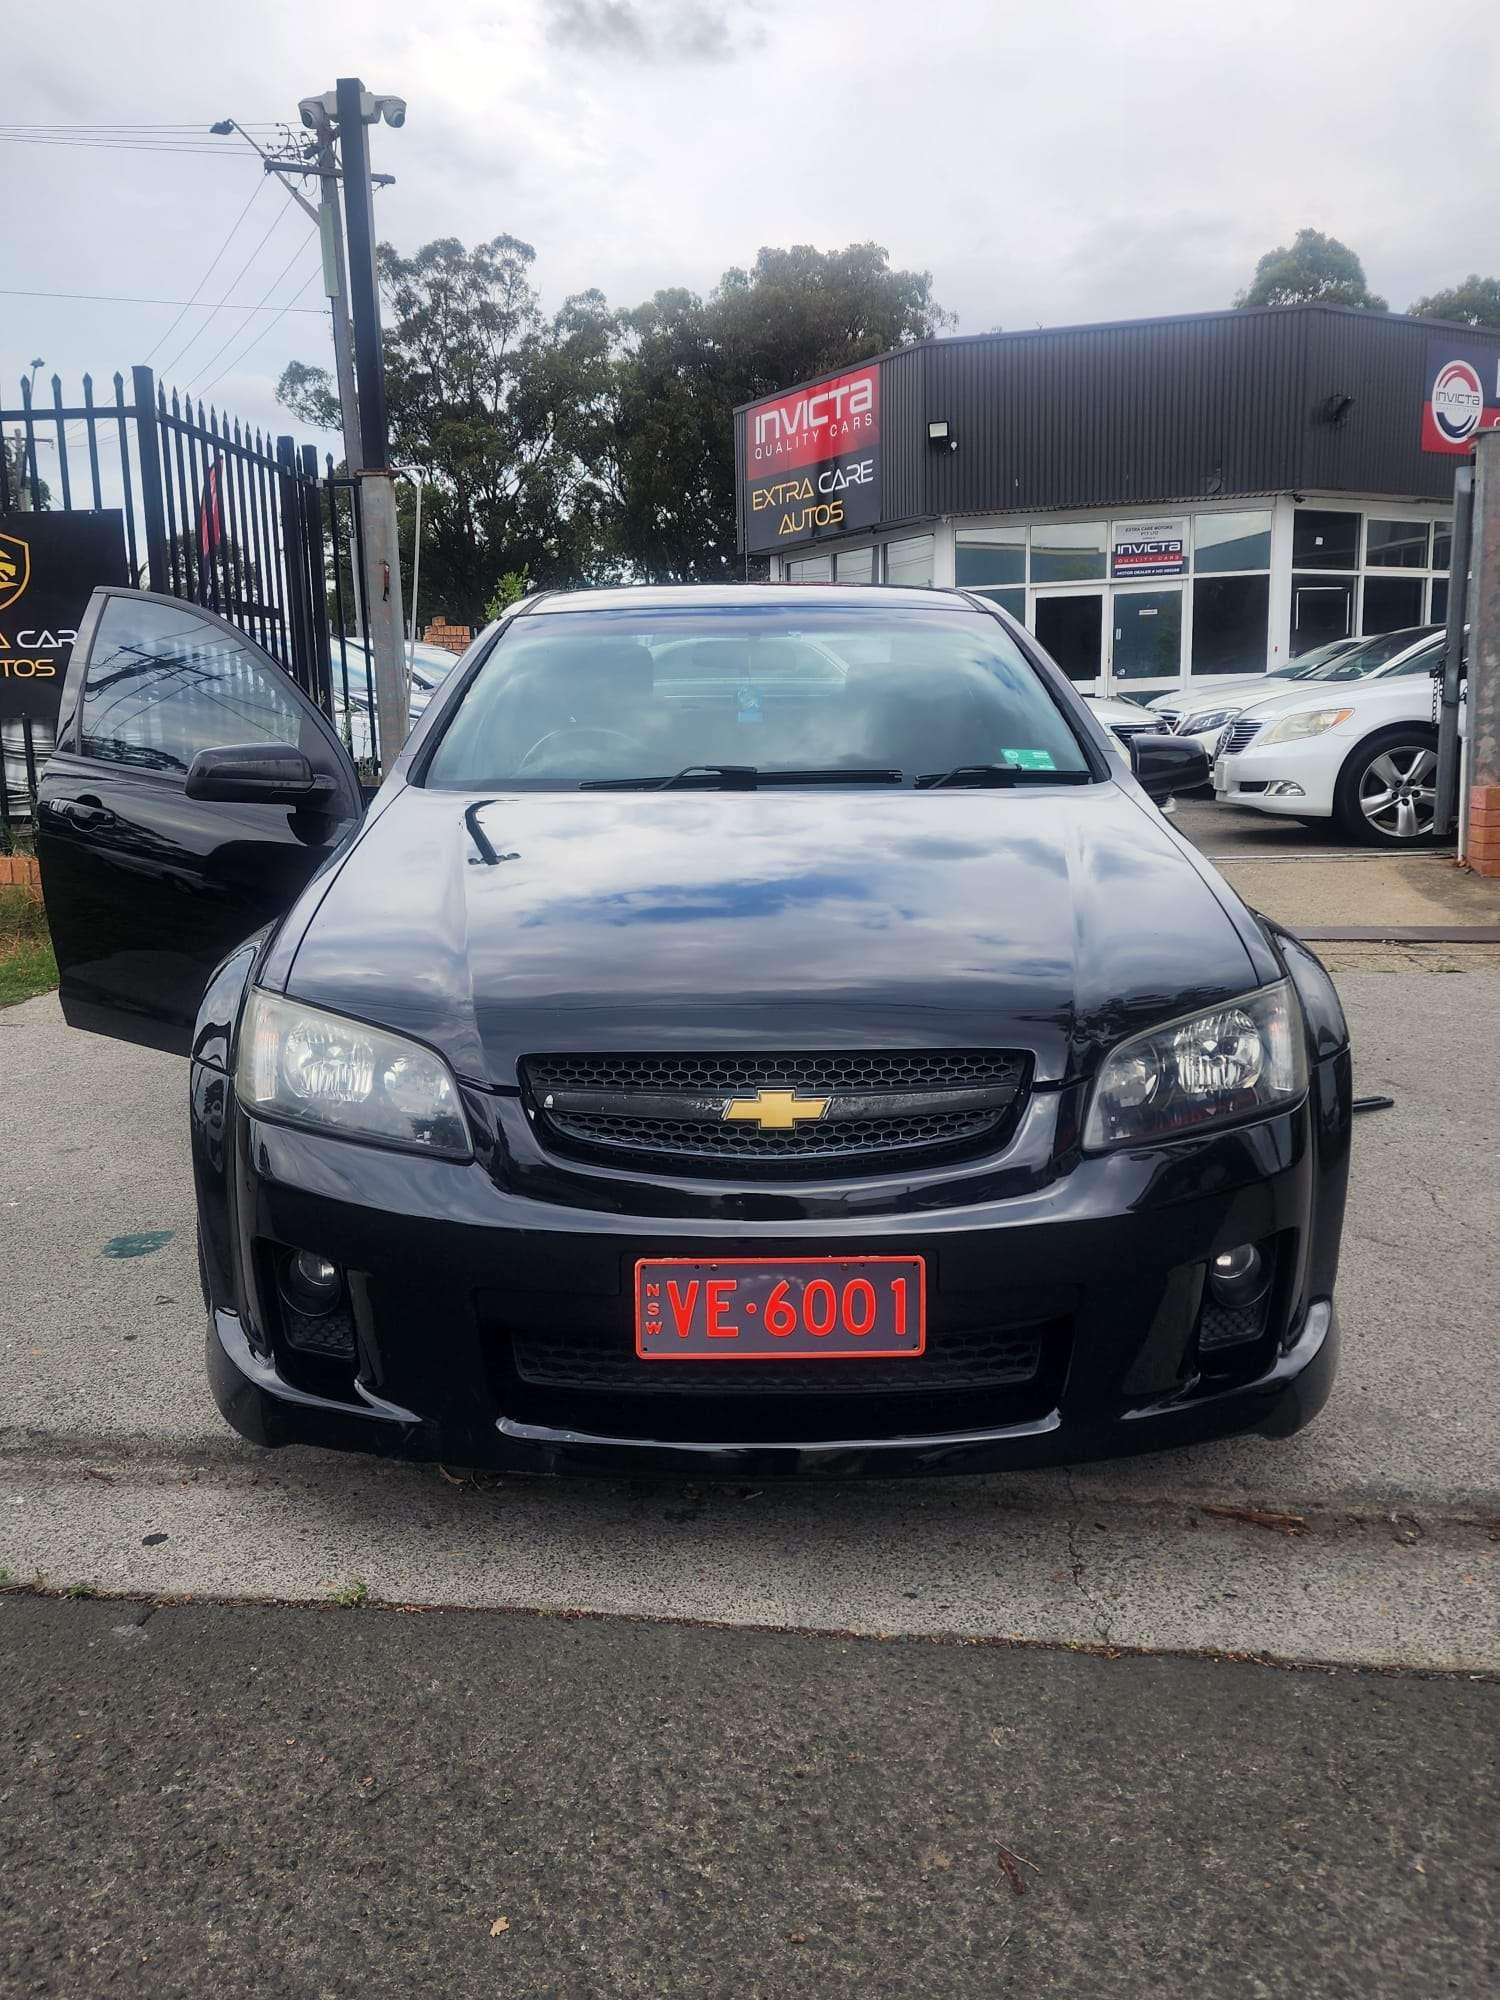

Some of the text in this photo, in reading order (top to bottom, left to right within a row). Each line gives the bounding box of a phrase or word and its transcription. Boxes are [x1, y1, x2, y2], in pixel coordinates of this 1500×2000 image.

[754, 413, 873, 460] QUALITY CARS
[752, 459, 874, 511] EXTRA CARE
[778, 500, 844, 535] AUTOS
[16, 629, 78, 649] CAR
[0, 658, 56, 678] TOS
[645, 1283, 663, 1335] NSW
